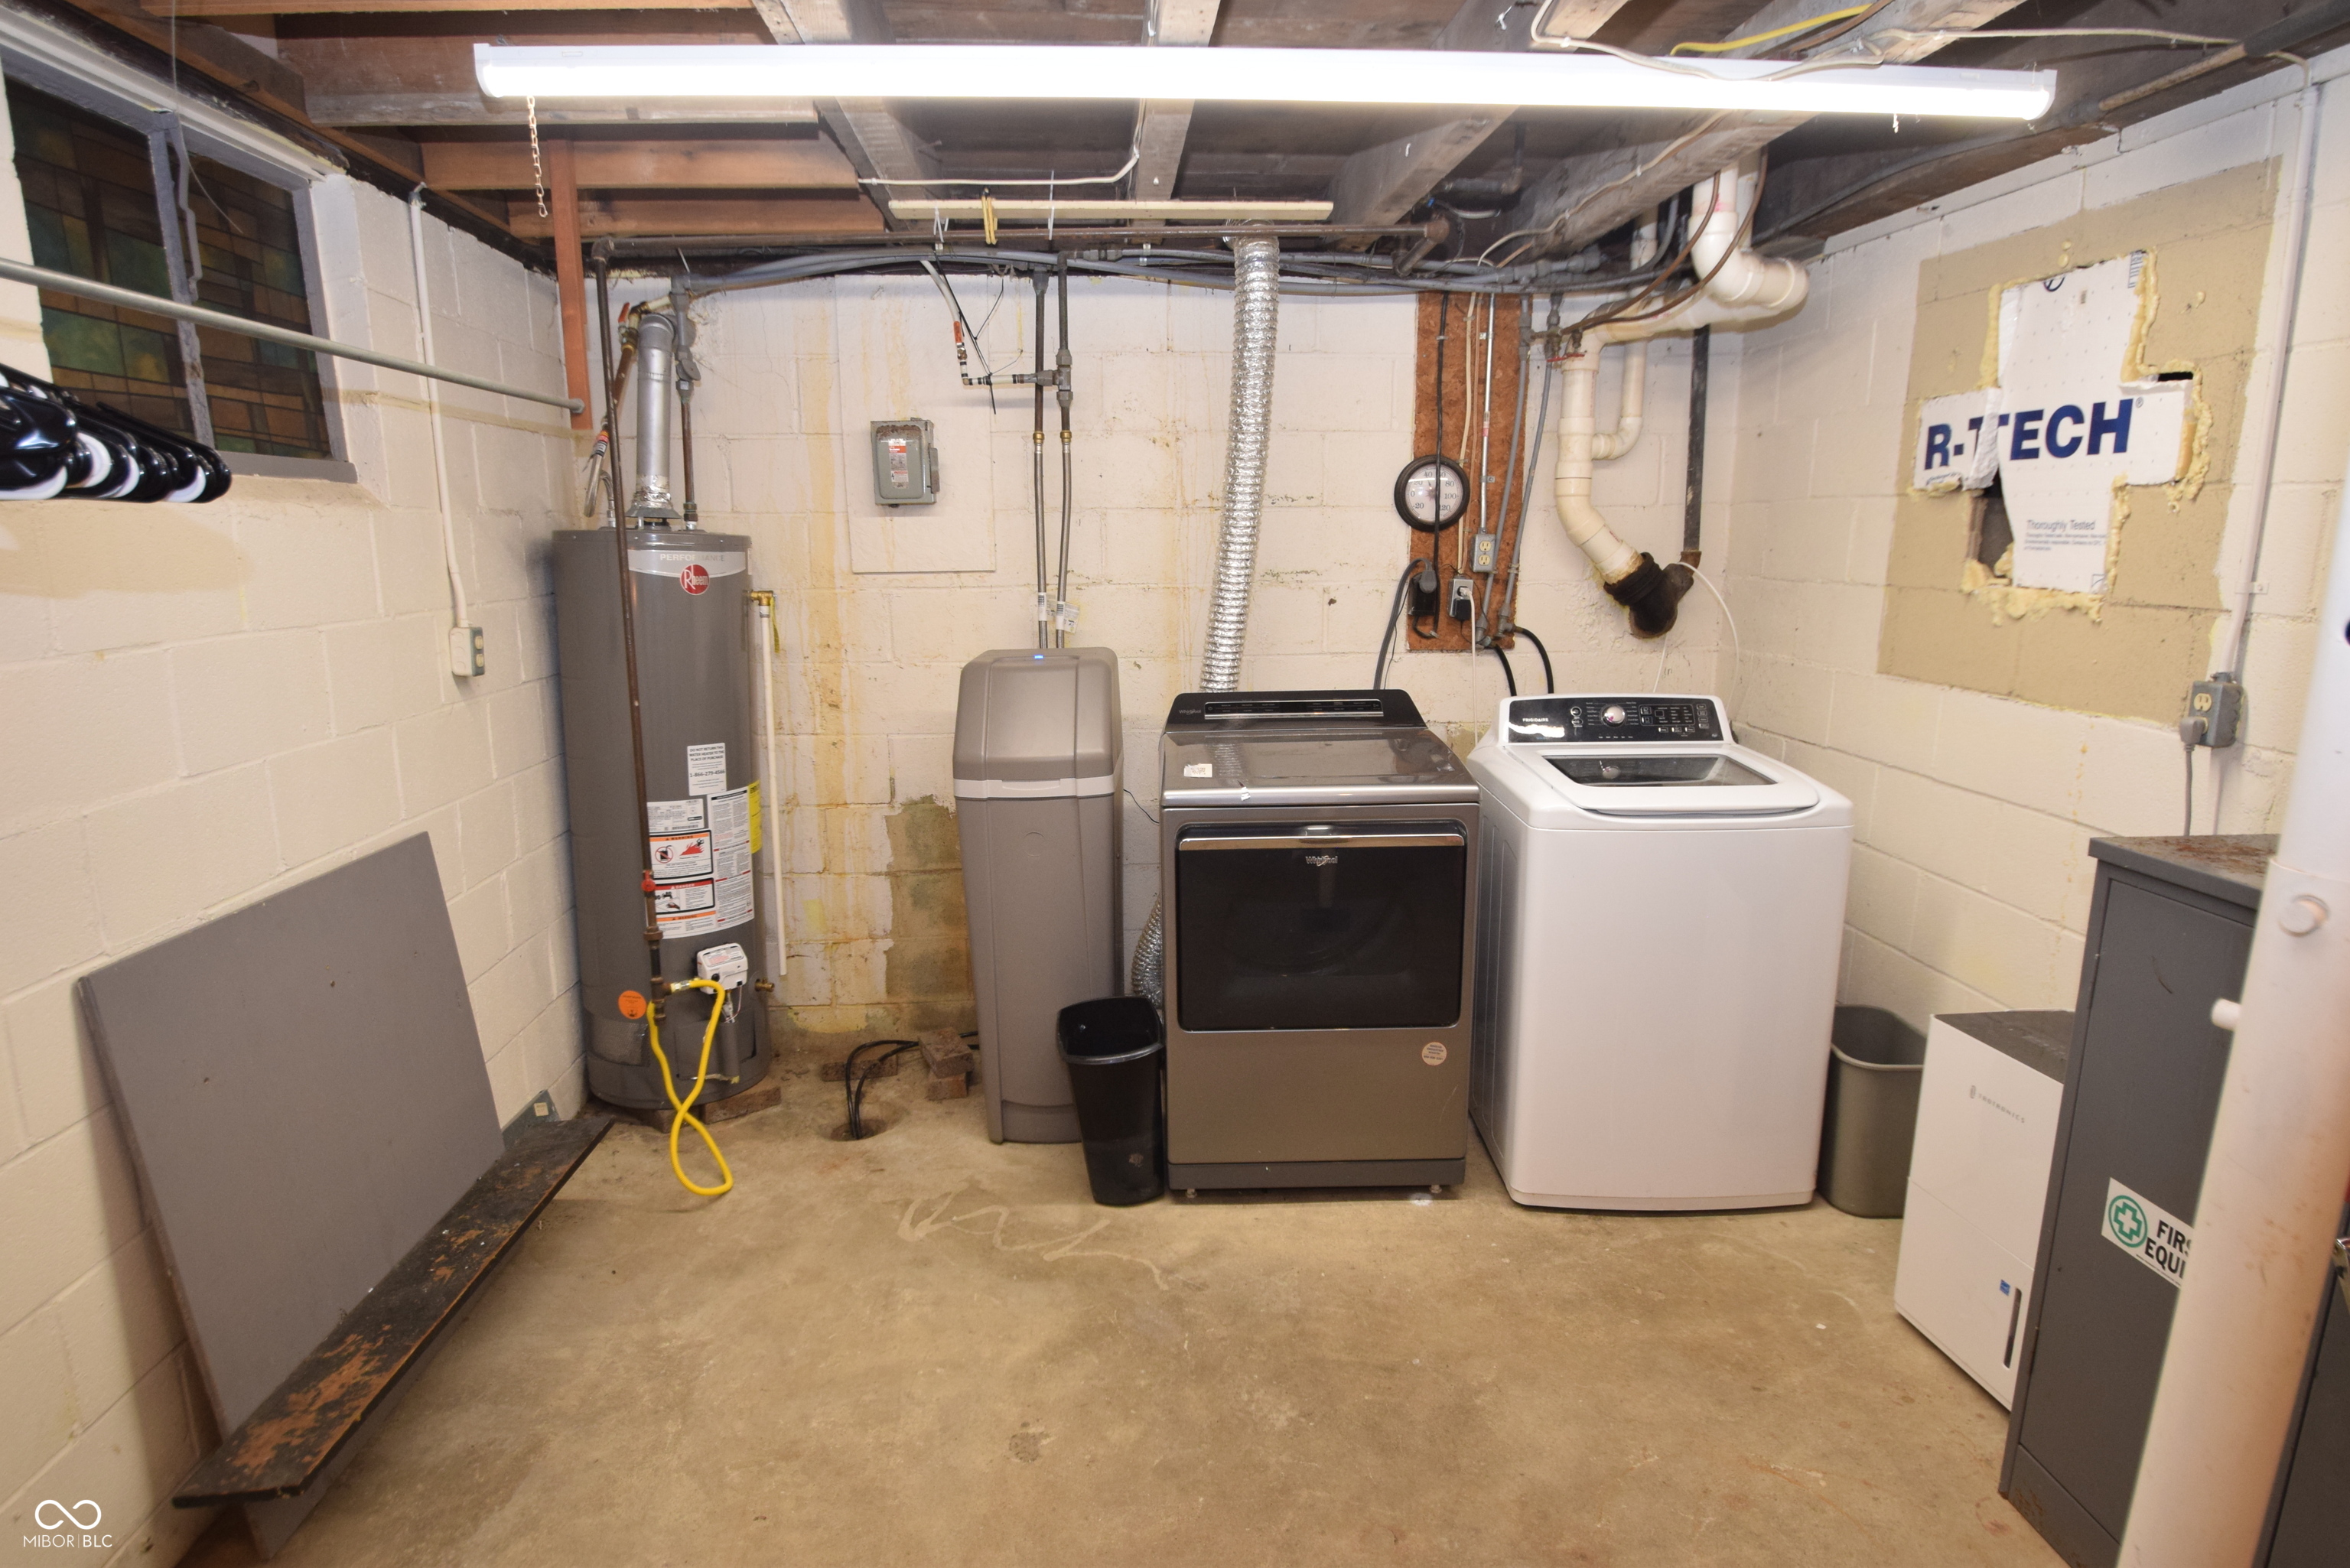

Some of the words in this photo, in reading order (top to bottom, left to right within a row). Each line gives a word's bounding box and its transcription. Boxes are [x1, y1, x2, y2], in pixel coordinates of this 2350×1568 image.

[2026, 519, 2067, 532] Thoroughly
[2070, 519, 2096, 530] Tested
[683, 564, 708, 590] Rheem
[1305, 855, 1338, 867] Whirlpool
